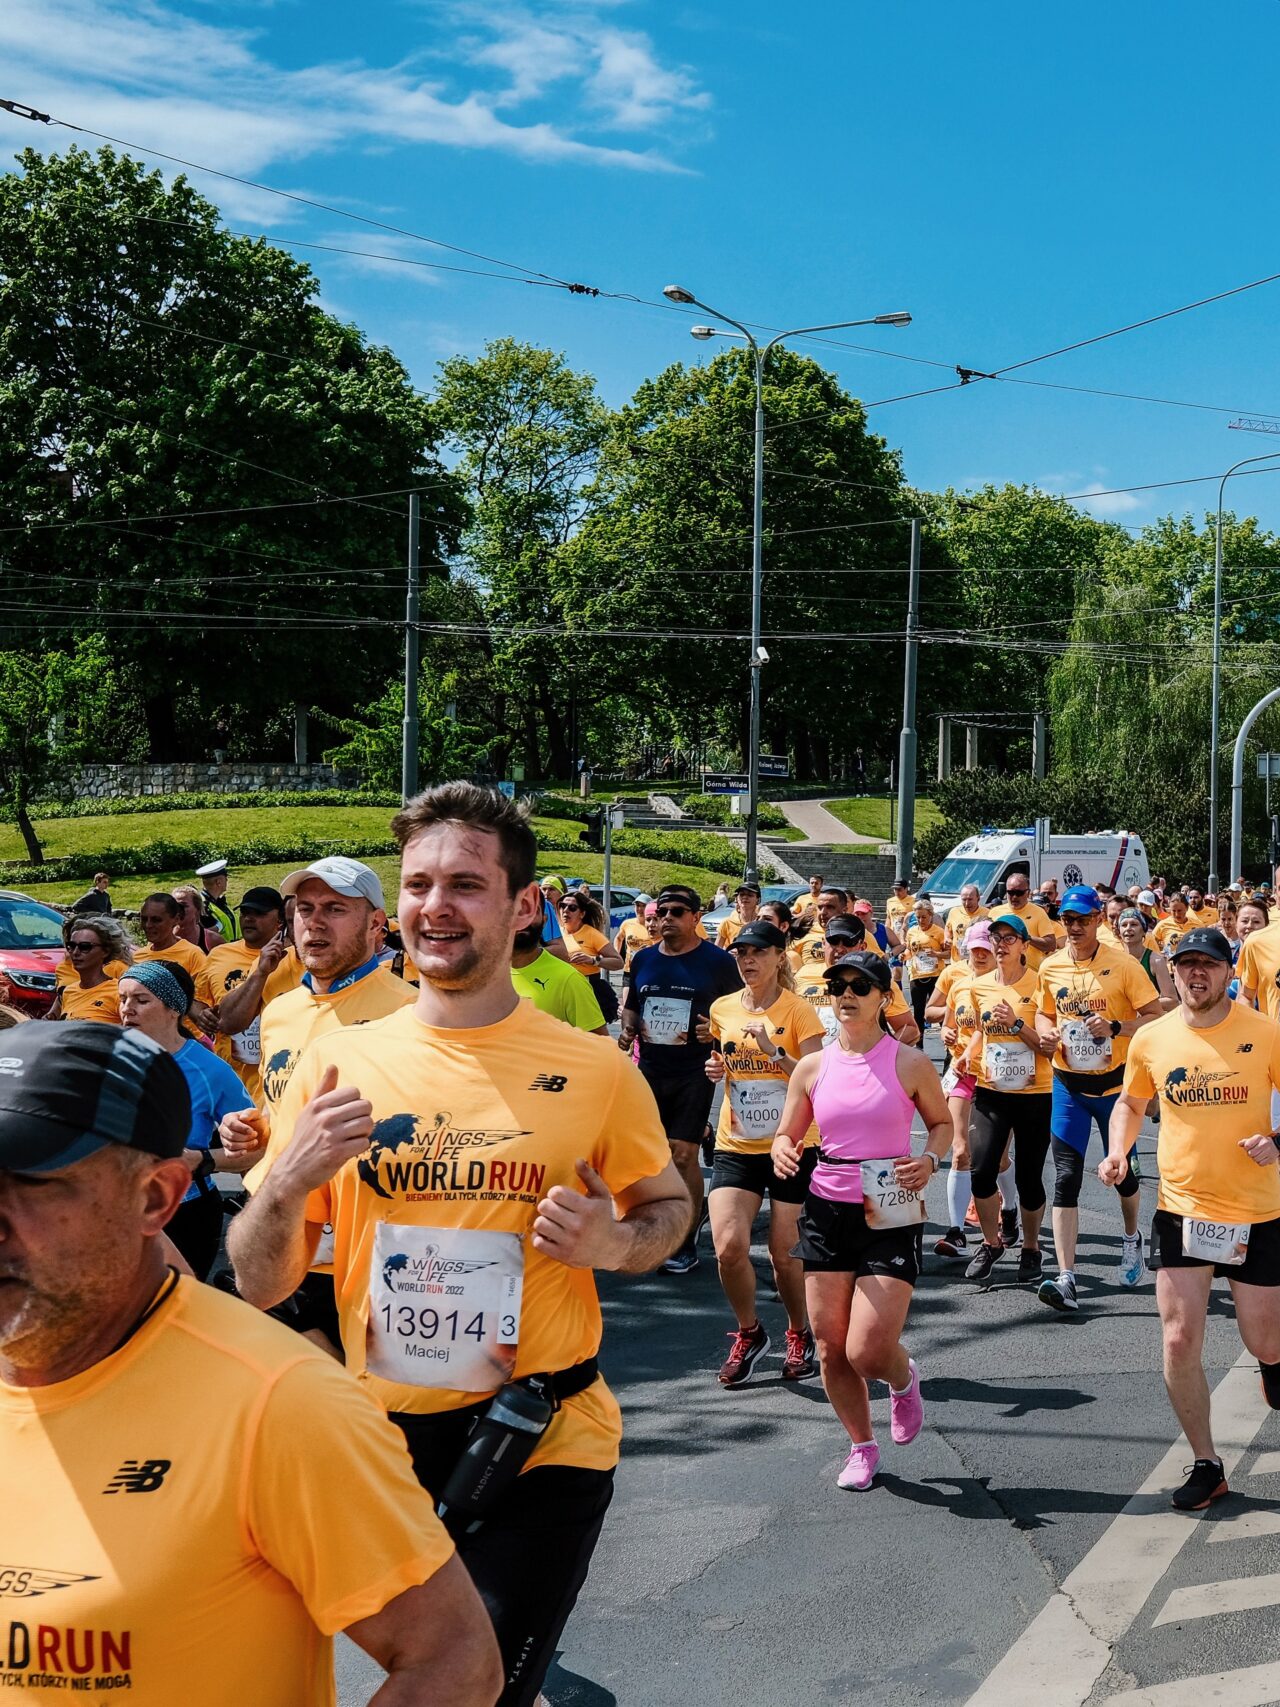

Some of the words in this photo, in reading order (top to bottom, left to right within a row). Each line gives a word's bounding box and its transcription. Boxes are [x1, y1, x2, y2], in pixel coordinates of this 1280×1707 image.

[1089, 999, 1107, 1009] RUN
[649, 1020, 680, 1031] 17177
[1069, 1045, 1102, 1056] 13806
[730, 1059, 764, 1071] WORLD
[994, 1065, 1026, 1076] 12008
[1186, 1073, 1219, 1081] WINGS
[1175, 1087, 1221, 1103] WORLD
[1222, 1085, 1249, 1100] RUN
[740, 1108, 779, 1122] 14000
[415, 1132, 487, 1146] WINGS
[410, 1146, 425, 1154] FOR
[422, 1147, 465, 1161] LIFE
[386, 1160, 486, 1192] WORLD
[488, 1160, 547, 1194] RUN
[405, 1192, 444, 1202] BIEGNIEMY
[444, 1191, 458, 1201] DLA
[458, 1191, 478, 1201] TYCH,
[479, 1190, 506, 1201] KTÓRZY
[507, 1192, 518, 1201] NIE
[1188, 1220, 1236, 1242] 10821
[1241, 1230, 1249, 1241] 3
[1197, 1237, 1222, 1249] Tomasz
[412, 1259, 465, 1273] WINGS
[416, 1271, 449, 1283] LIFE
[396, 1281, 426, 1293] WORLD
[426, 1282, 443, 1294] RUN
[444, 1285, 465, 1296] 2022
[381, 1303, 486, 1342] 13914
[501, 1314, 516, 1337] 3
[404, 1343, 450, 1363] Maciej
[471, 1465, 495, 1501] EVADICT
[37, 1624, 132, 1675] RUN
[0, 1673, 24, 1688] YCH,
[27, 1671, 69, 1689] KTÓRZY
[71, 1677, 92, 1691] NIE
[94, 1673, 132, 1690] MOGĄ
